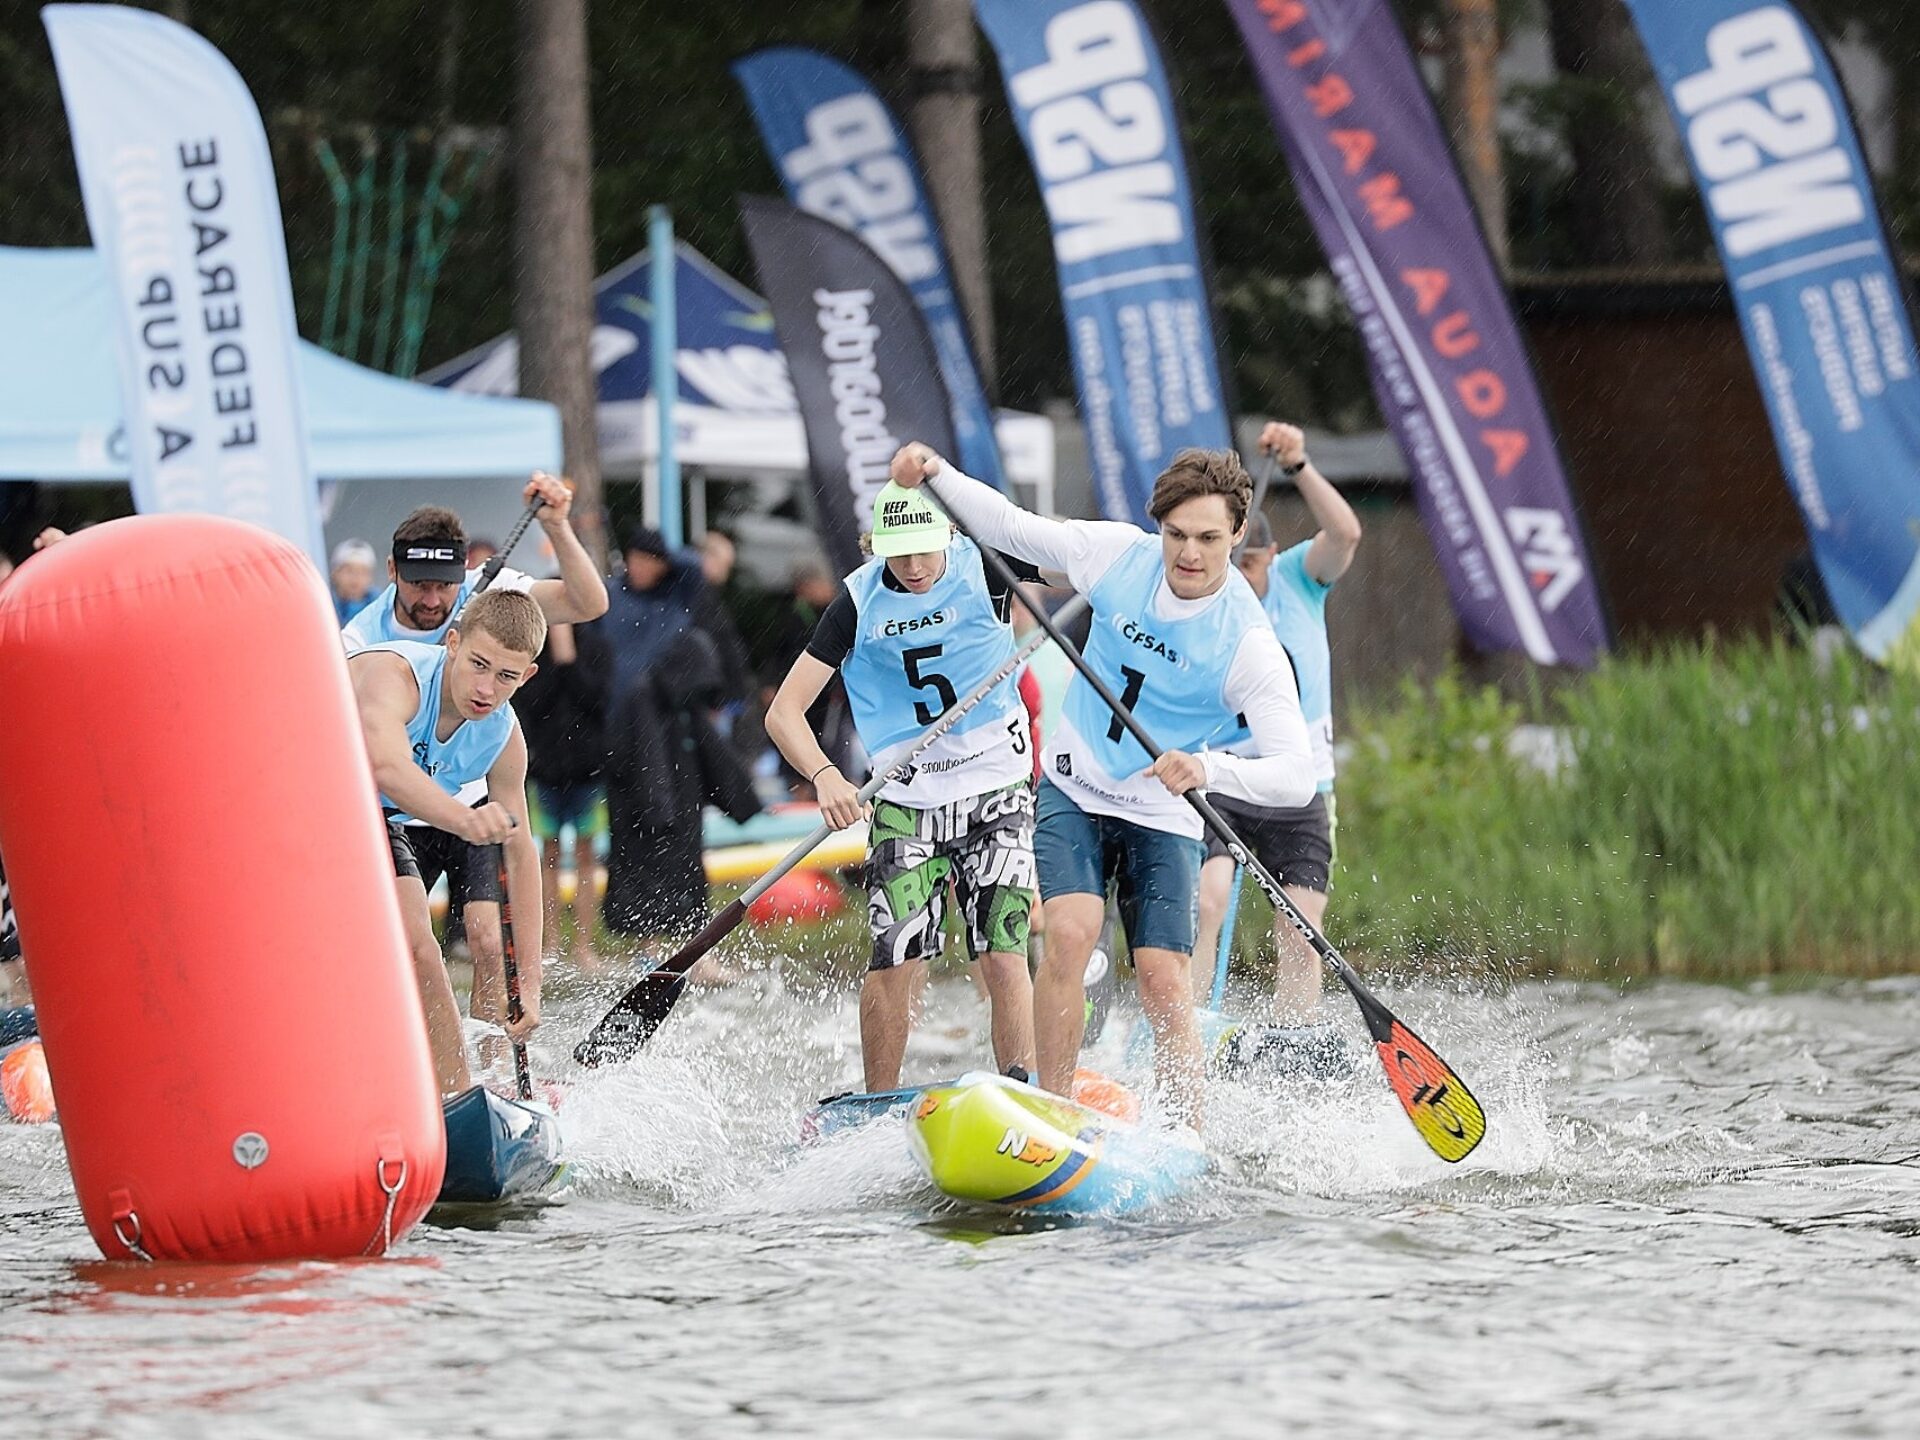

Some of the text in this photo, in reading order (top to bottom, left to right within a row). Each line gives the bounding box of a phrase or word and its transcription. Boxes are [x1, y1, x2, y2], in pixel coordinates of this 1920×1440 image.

[882, 500, 909, 516] KEEP
[882, 511, 933, 529] PADDLING
[407, 547, 455, 561] SIC
[884, 609, 945, 638] ČFSAS
[1122, 621, 1178, 664] ČFSAS
[902, 643, 958, 727] 5
[1106, 664, 1146, 745] 1
[1247, 861, 1316, 941] QUICKBLADE
[996, 1126, 1057, 1168] NSP
